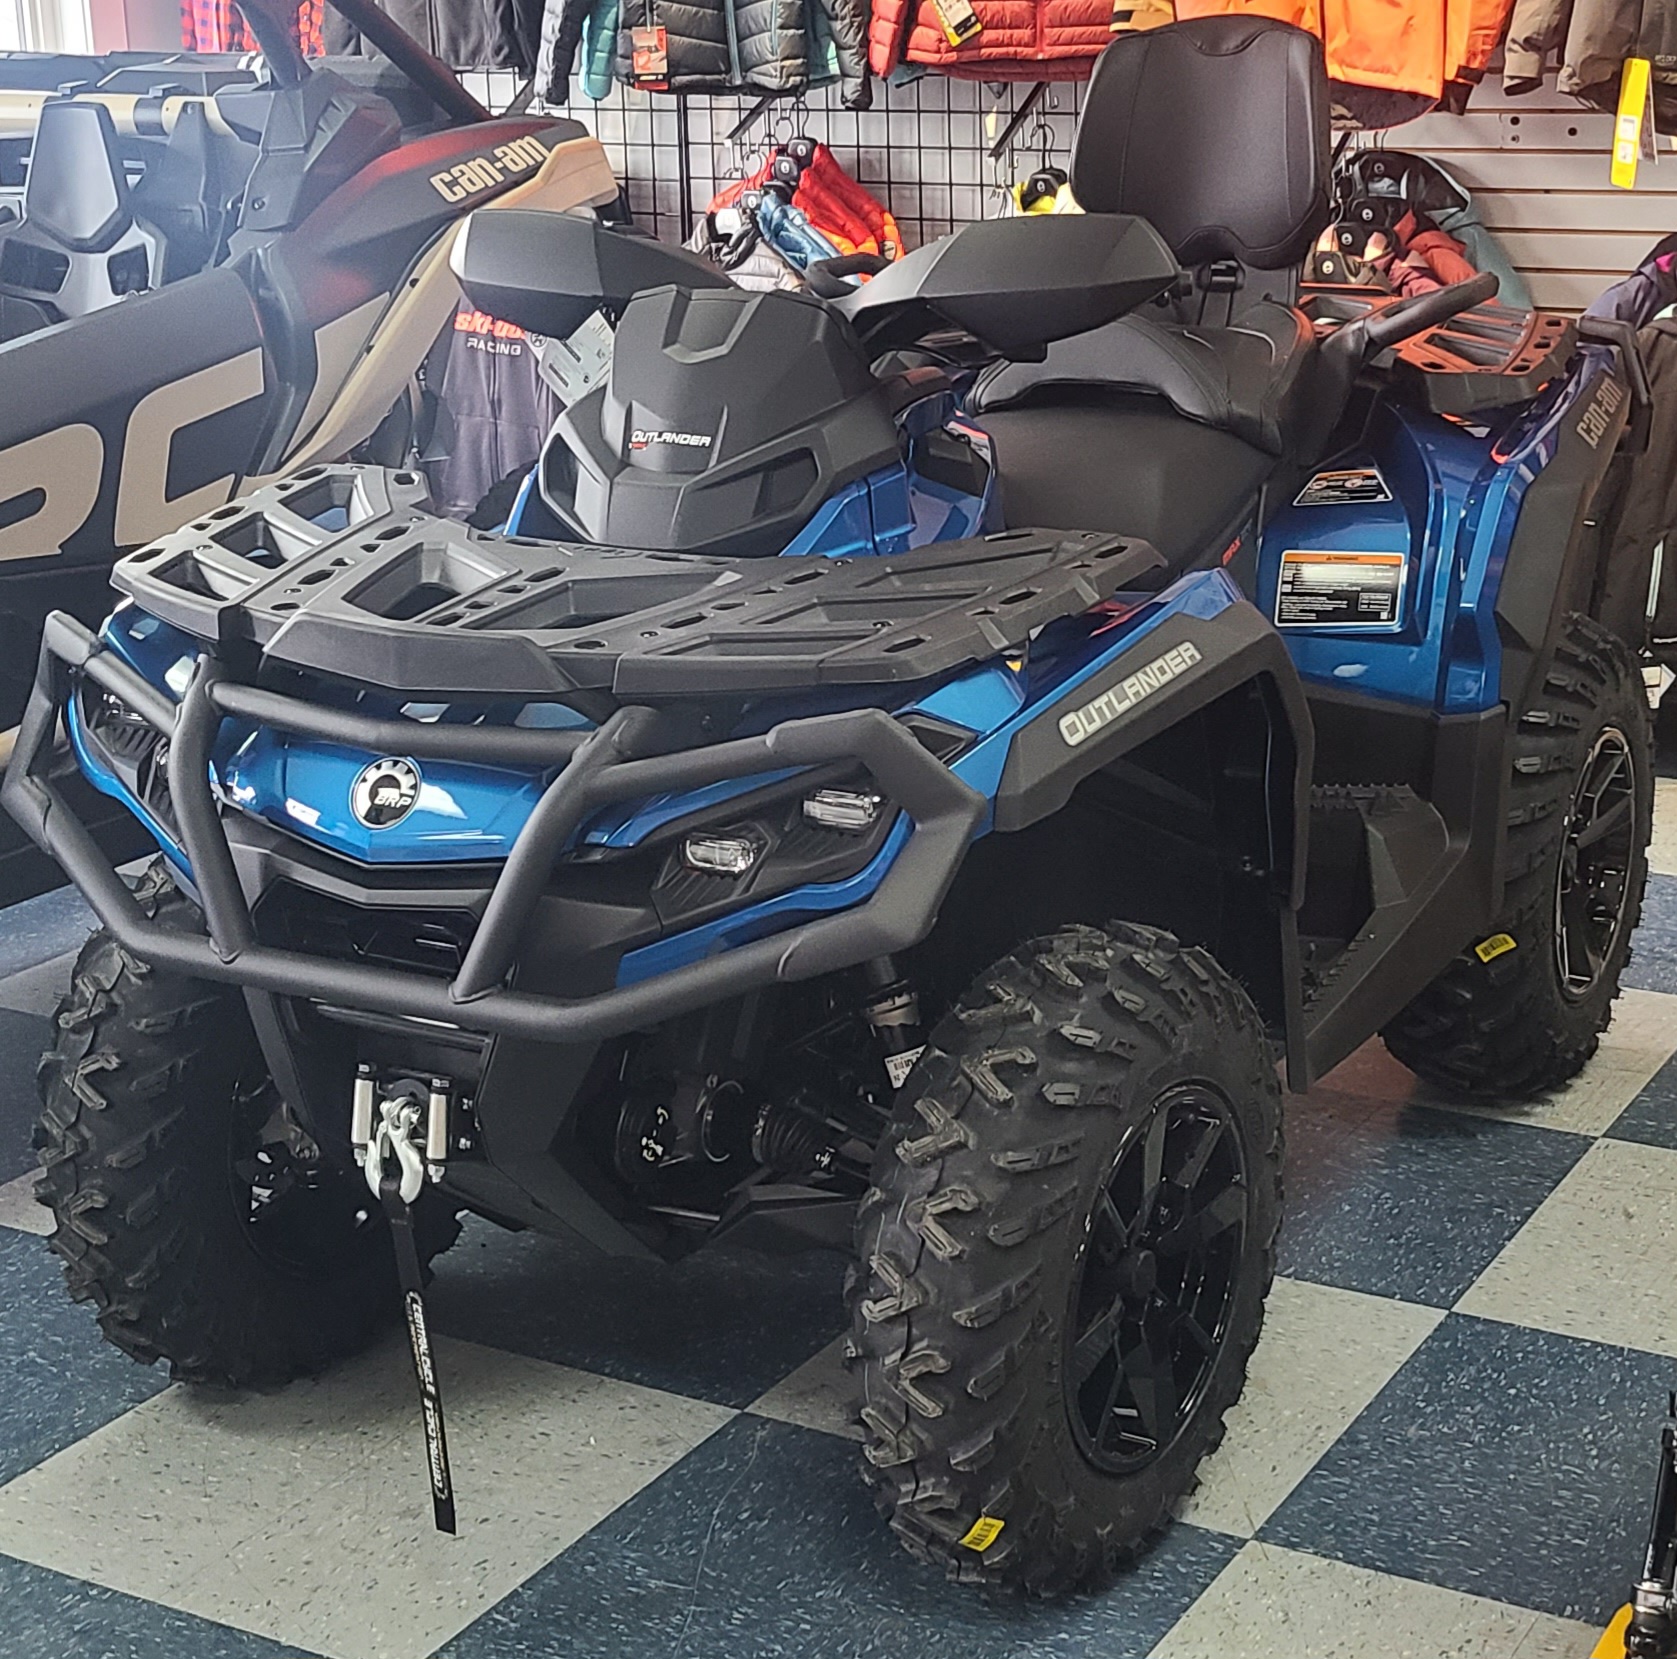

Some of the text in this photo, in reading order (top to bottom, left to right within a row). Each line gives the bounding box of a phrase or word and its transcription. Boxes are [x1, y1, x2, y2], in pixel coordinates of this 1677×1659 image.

[429, 135, 551, 203] can-am
[466, 337, 522, 356] RACING
[630, 430, 712, 448] OUTLANDER
[1058, 640, 1203, 747] OUTLANDER
[373, 790, 413, 809] BRP
